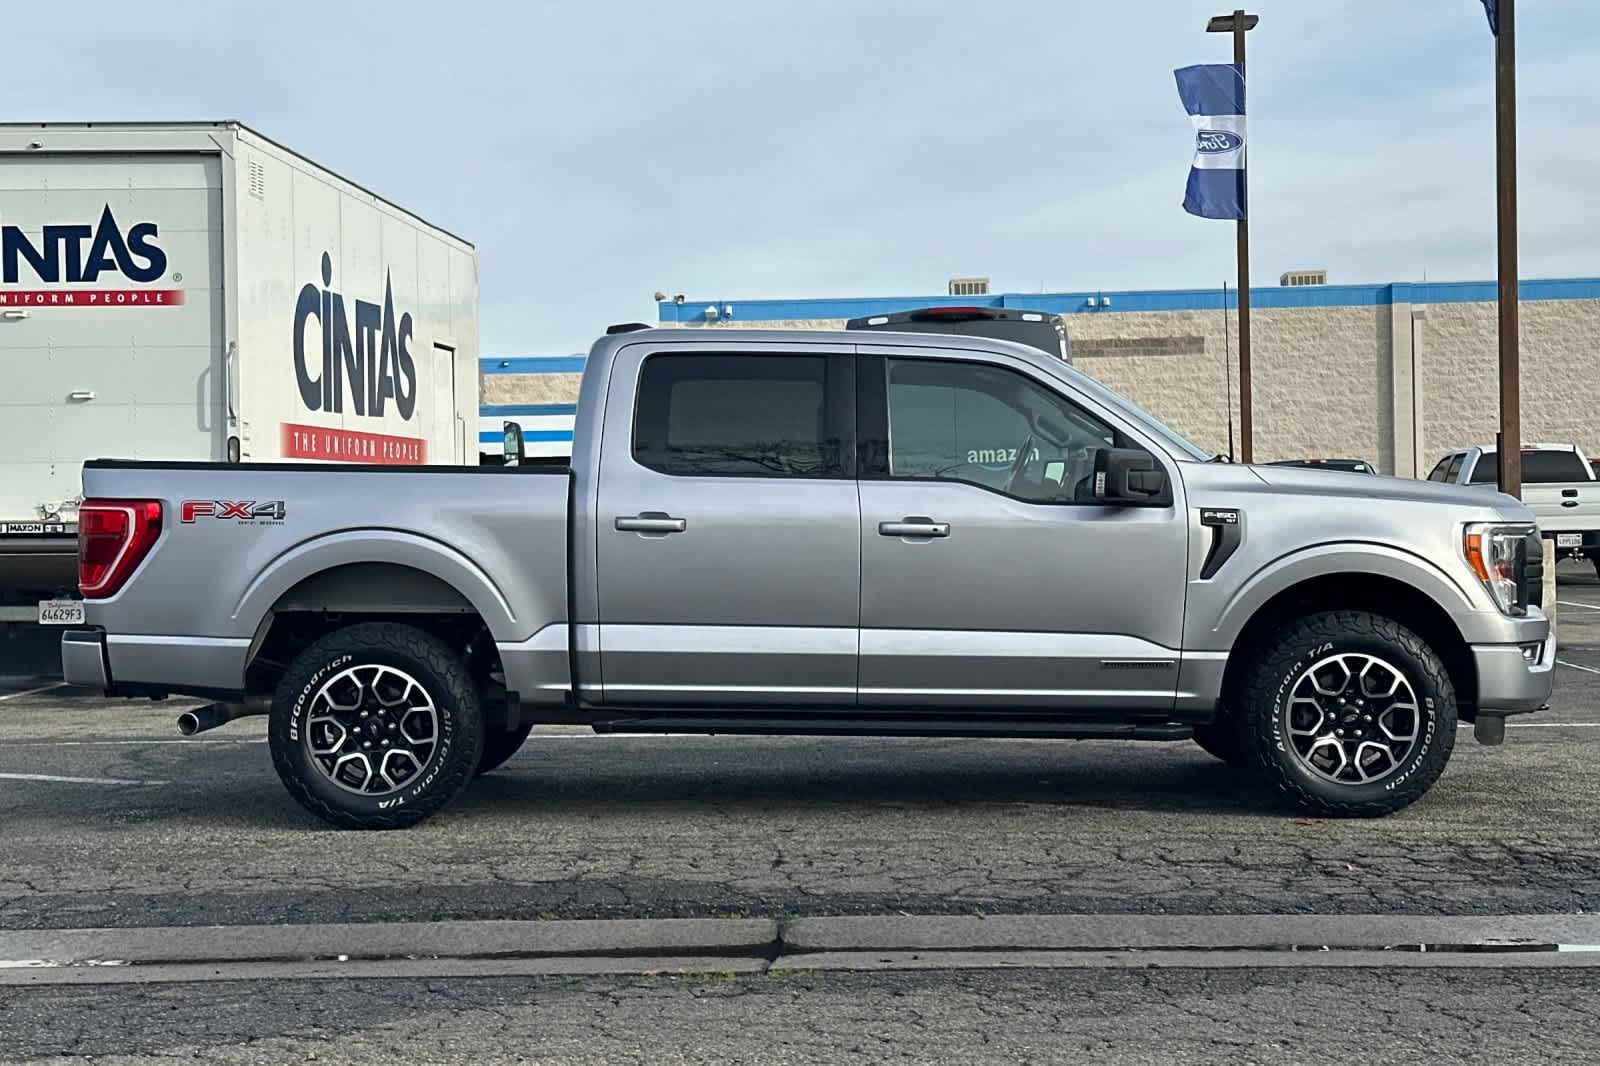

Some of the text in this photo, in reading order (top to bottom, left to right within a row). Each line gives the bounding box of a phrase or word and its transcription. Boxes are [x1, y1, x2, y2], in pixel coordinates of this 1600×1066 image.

[2, 202, 167, 283] NTAS
[90, 293, 163, 303] PEOPLE
[294, 431, 419, 462] THE UNIFORM PEOPLE
[967, 447, 1040, 464] amazn
[181, 499, 286, 524] FX4
[9, 524, 41, 532] MAXON
[41, 608, 82, 621] 64629F3
[1307, 641, 1334, 659] T/A
[289, 655, 353, 741] BFGoodrich
[1385, 697, 1436, 791] BFGoodrich
[378, 796, 406, 809] T/A
